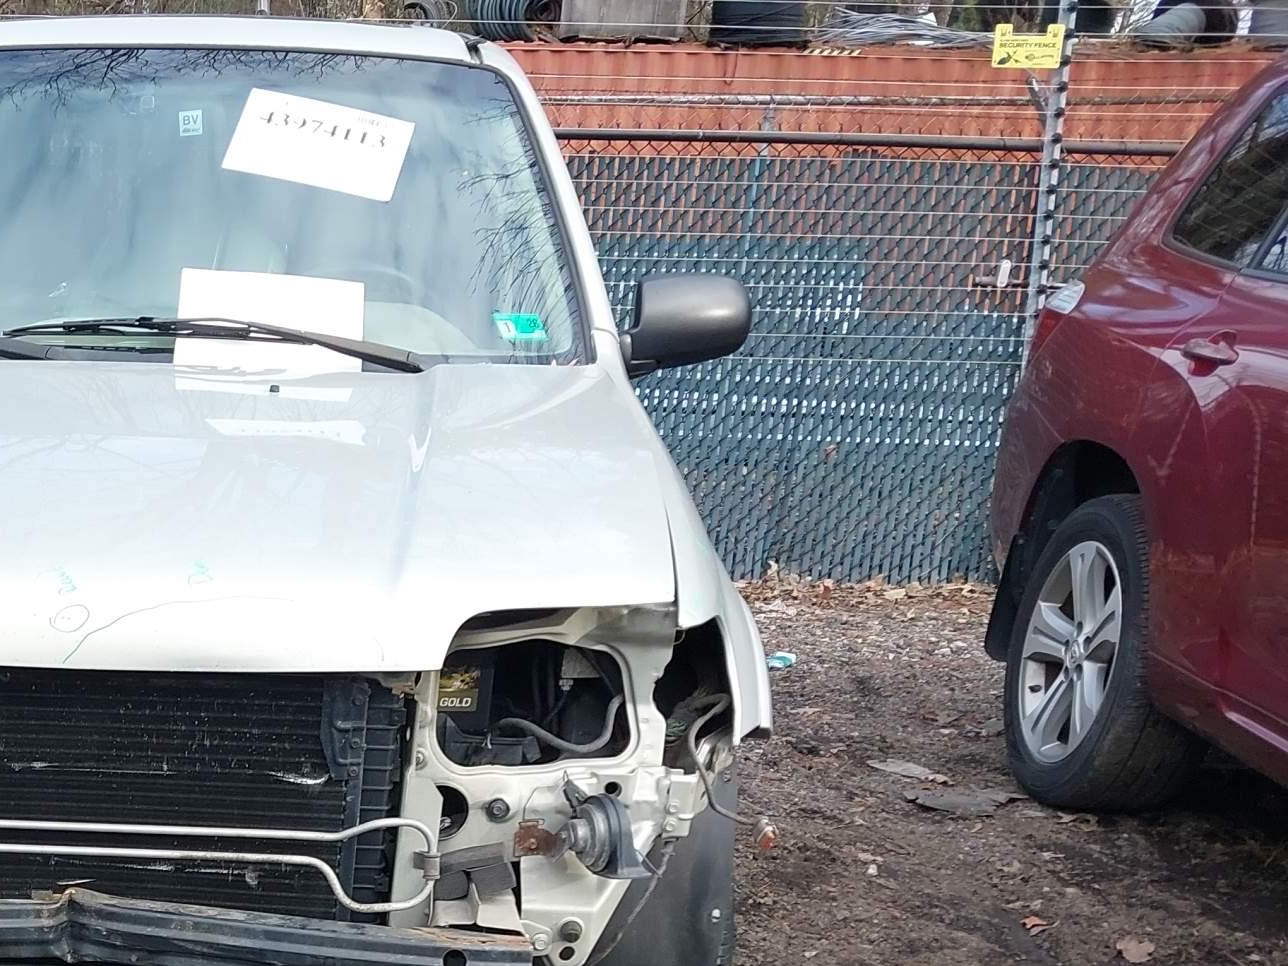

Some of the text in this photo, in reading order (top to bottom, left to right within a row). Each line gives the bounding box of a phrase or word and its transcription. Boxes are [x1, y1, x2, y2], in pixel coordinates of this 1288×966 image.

[183, 114, 199, 126] BV
[259, 111, 388, 150] 43974113
[439, 697, 472, 707] GOLD
